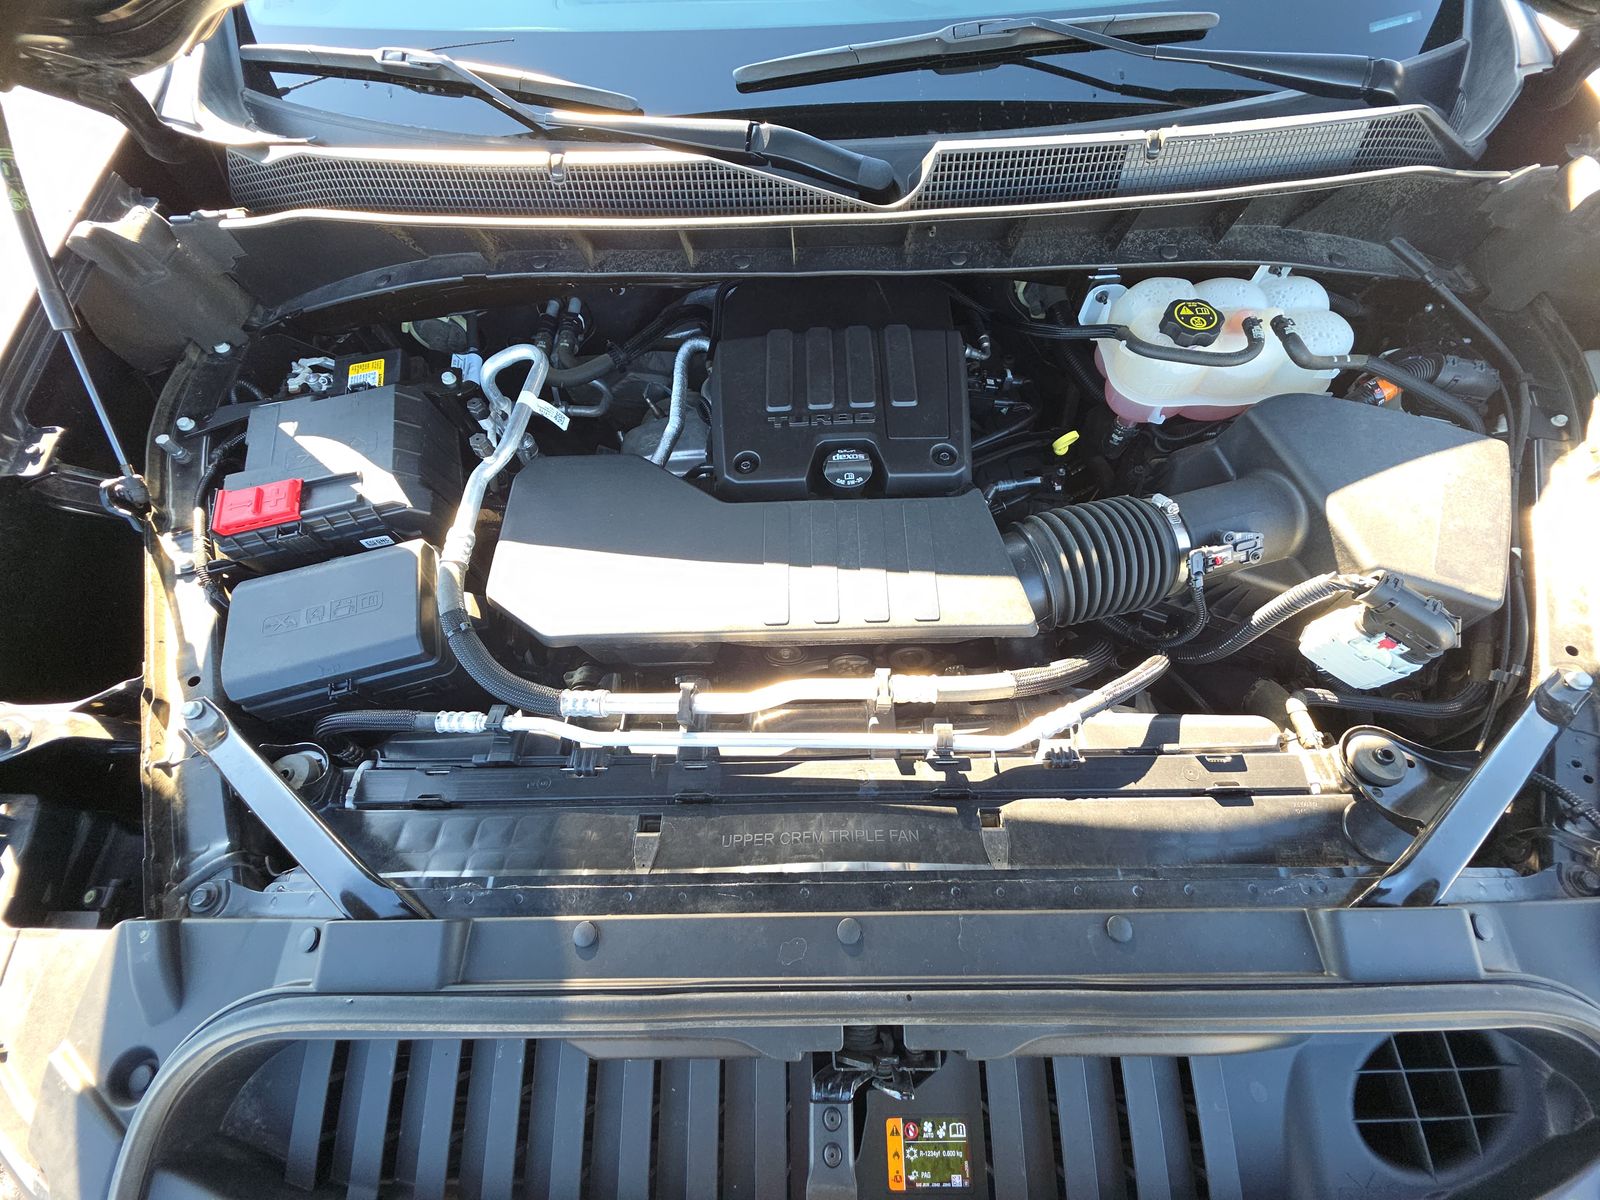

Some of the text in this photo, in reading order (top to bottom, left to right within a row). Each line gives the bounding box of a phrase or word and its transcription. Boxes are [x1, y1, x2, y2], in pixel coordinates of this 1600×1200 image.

[767, 412, 876, 428] TURBO
[832, 453, 865, 461] dexos
[721, 829, 920, 848] UPPER CRFM TRIPLE FAN
